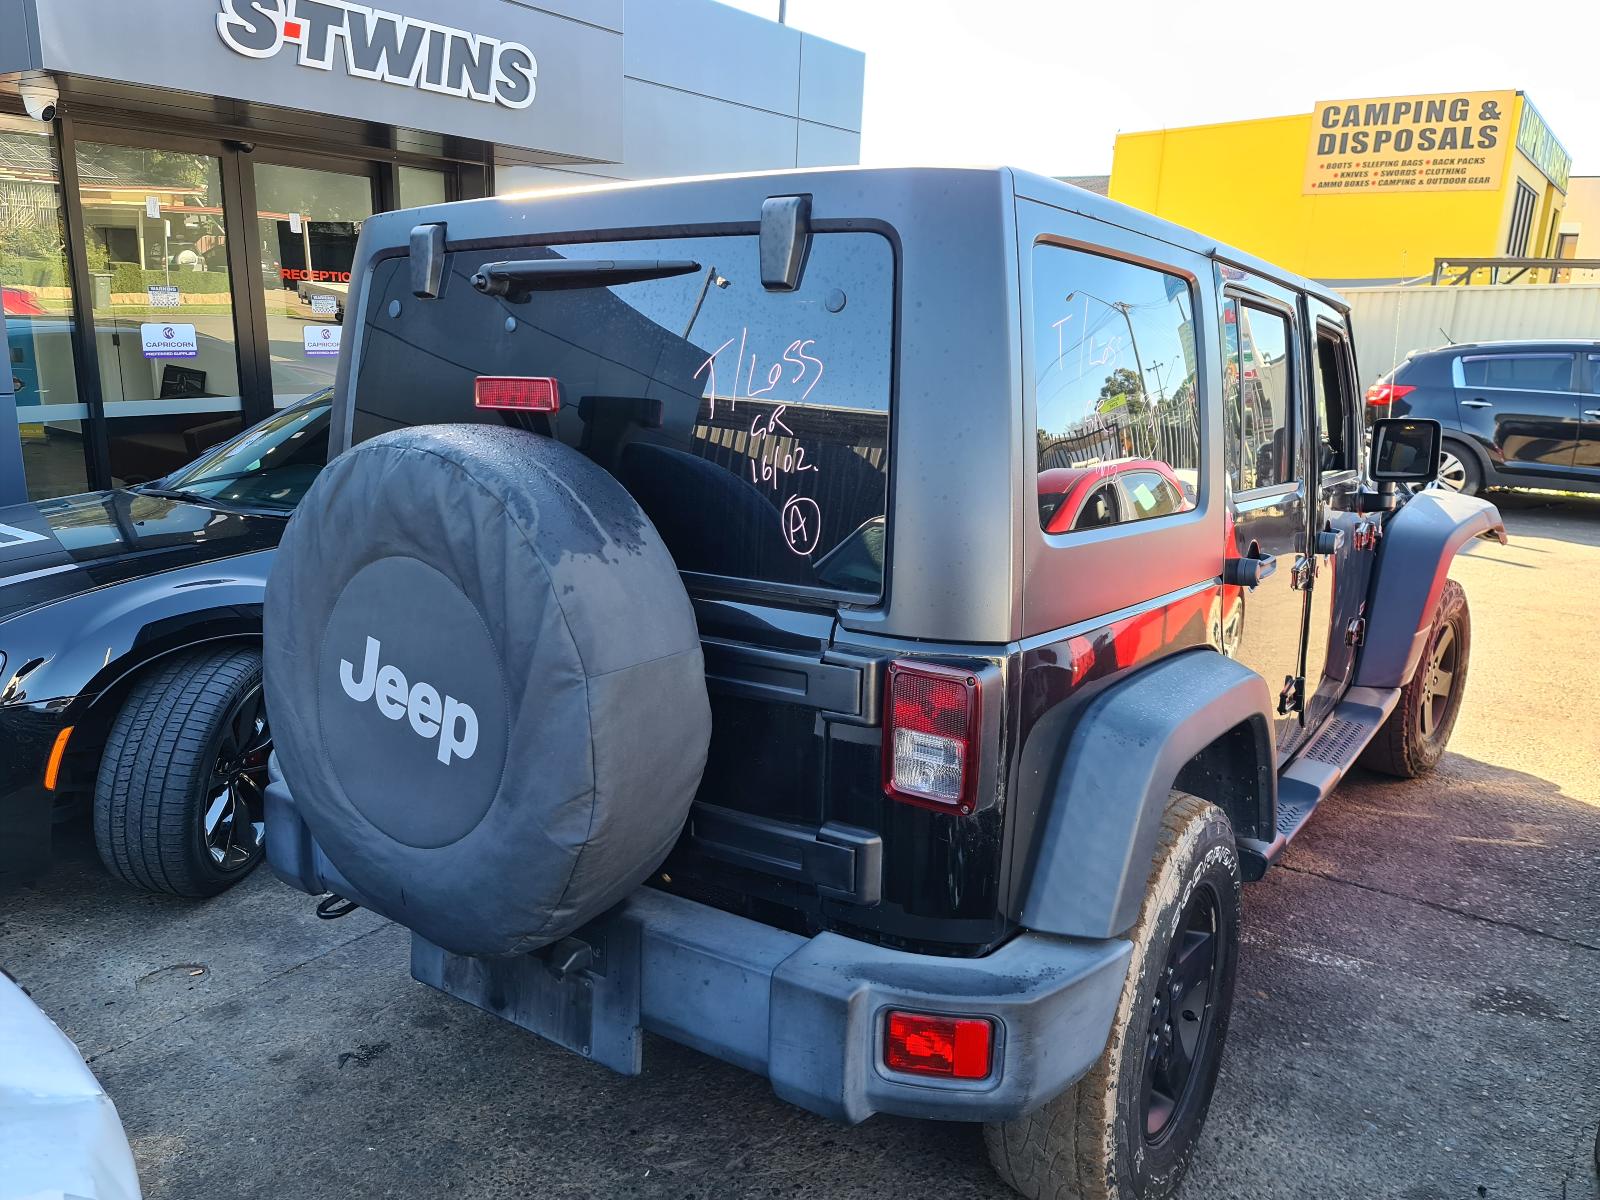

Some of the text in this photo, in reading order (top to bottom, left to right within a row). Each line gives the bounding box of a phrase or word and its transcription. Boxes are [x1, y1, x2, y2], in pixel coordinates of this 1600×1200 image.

[1322, 98, 1501, 128] CAMPING &
[1317, 125, 1498, 155] DISPOSALS
[1326, 157, 1485, 169] BOOTS SLEEPING BAGS BACK PACKS
[1340, 167, 1467, 178] KNIVES SWORDS CLOTHING
[1317, 180, 1343, 188] AMMO
[1344, 180, 1369, 188] BOXES
[1378, 178, 1416, 186] CAMPING
[1427, 177, 1466, 185] OUTDOOR
[1468, 176, 1491, 184] GEAR
[339, 635, 479, 766] Jeep
